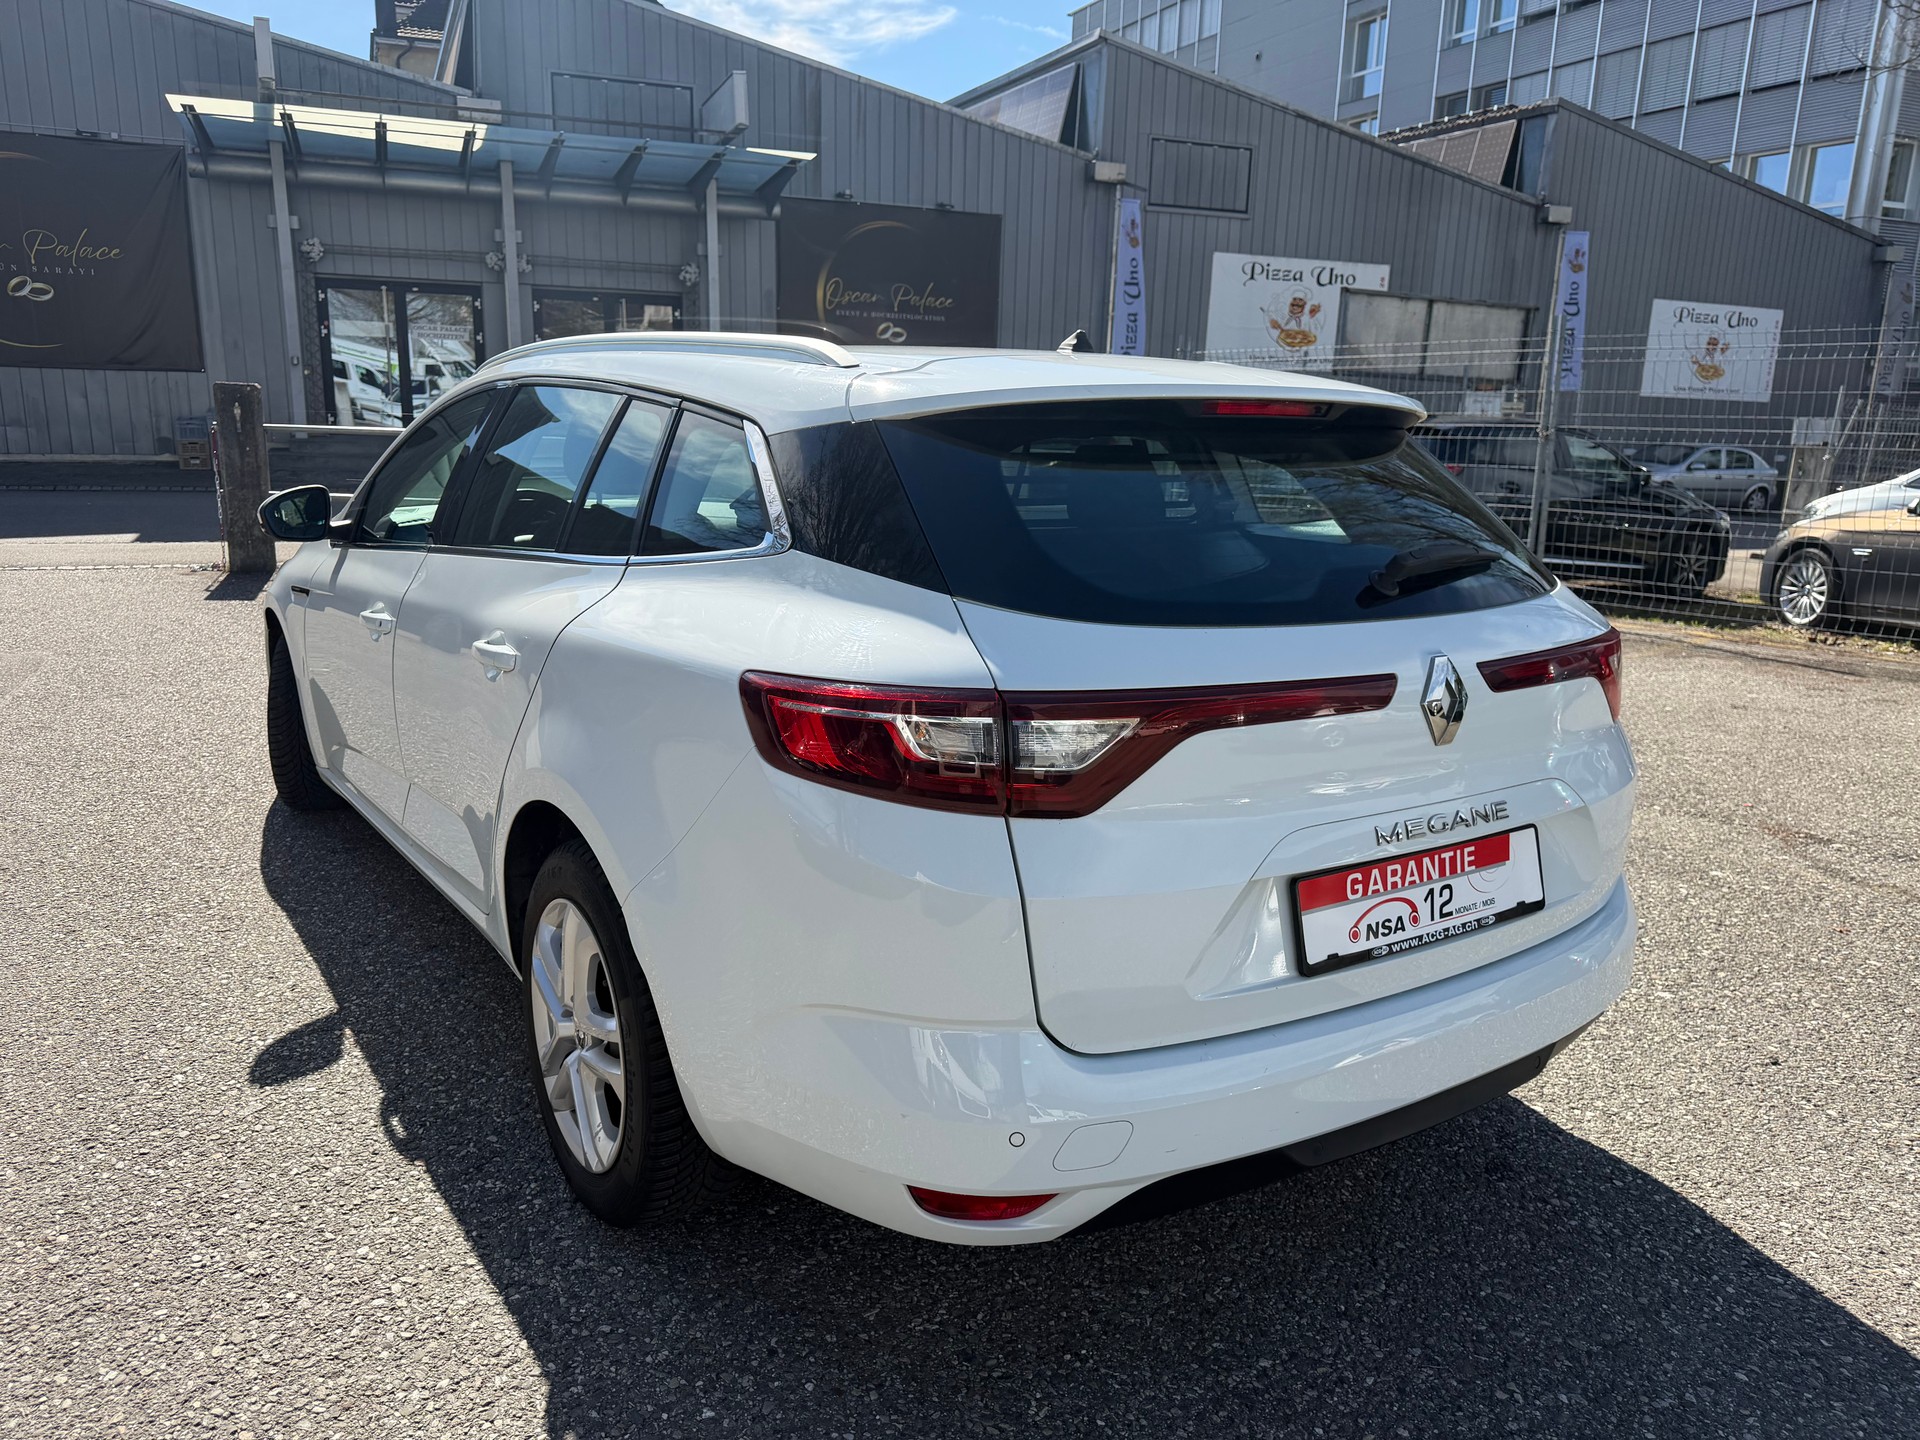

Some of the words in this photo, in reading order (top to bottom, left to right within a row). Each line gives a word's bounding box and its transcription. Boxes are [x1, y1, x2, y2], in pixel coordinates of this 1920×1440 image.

[23, 228, 124, 267] Palace
[1123, 257, 1141, 306] Uno
[1242, 261, 1304, 287] Pizza
[1310, 265, 1357, 287] Uno
[825, 277, 882, 310] Oscar
[890, 282, 956, 313] Palace
[1563, 281, 1580, 317] Uno
[1120, 312, 1138, 355] izza
[1673, 306, 1719, 328] Pizza
[1724, 310, 1759, 328] Uno
[1374, 800, 1510, 846] MEGANE
[1346, 846, 1476, 900] GARANTIE
[1424, 883, 1454, 921] 12
[1454, 902, 1478, 915] MONATE
[1482, 897, 1496, 908] MOIS
[1365, 915, 1406, 941] NSA
[1391, 921, 1479, 953] www.ACG-AG.ch
